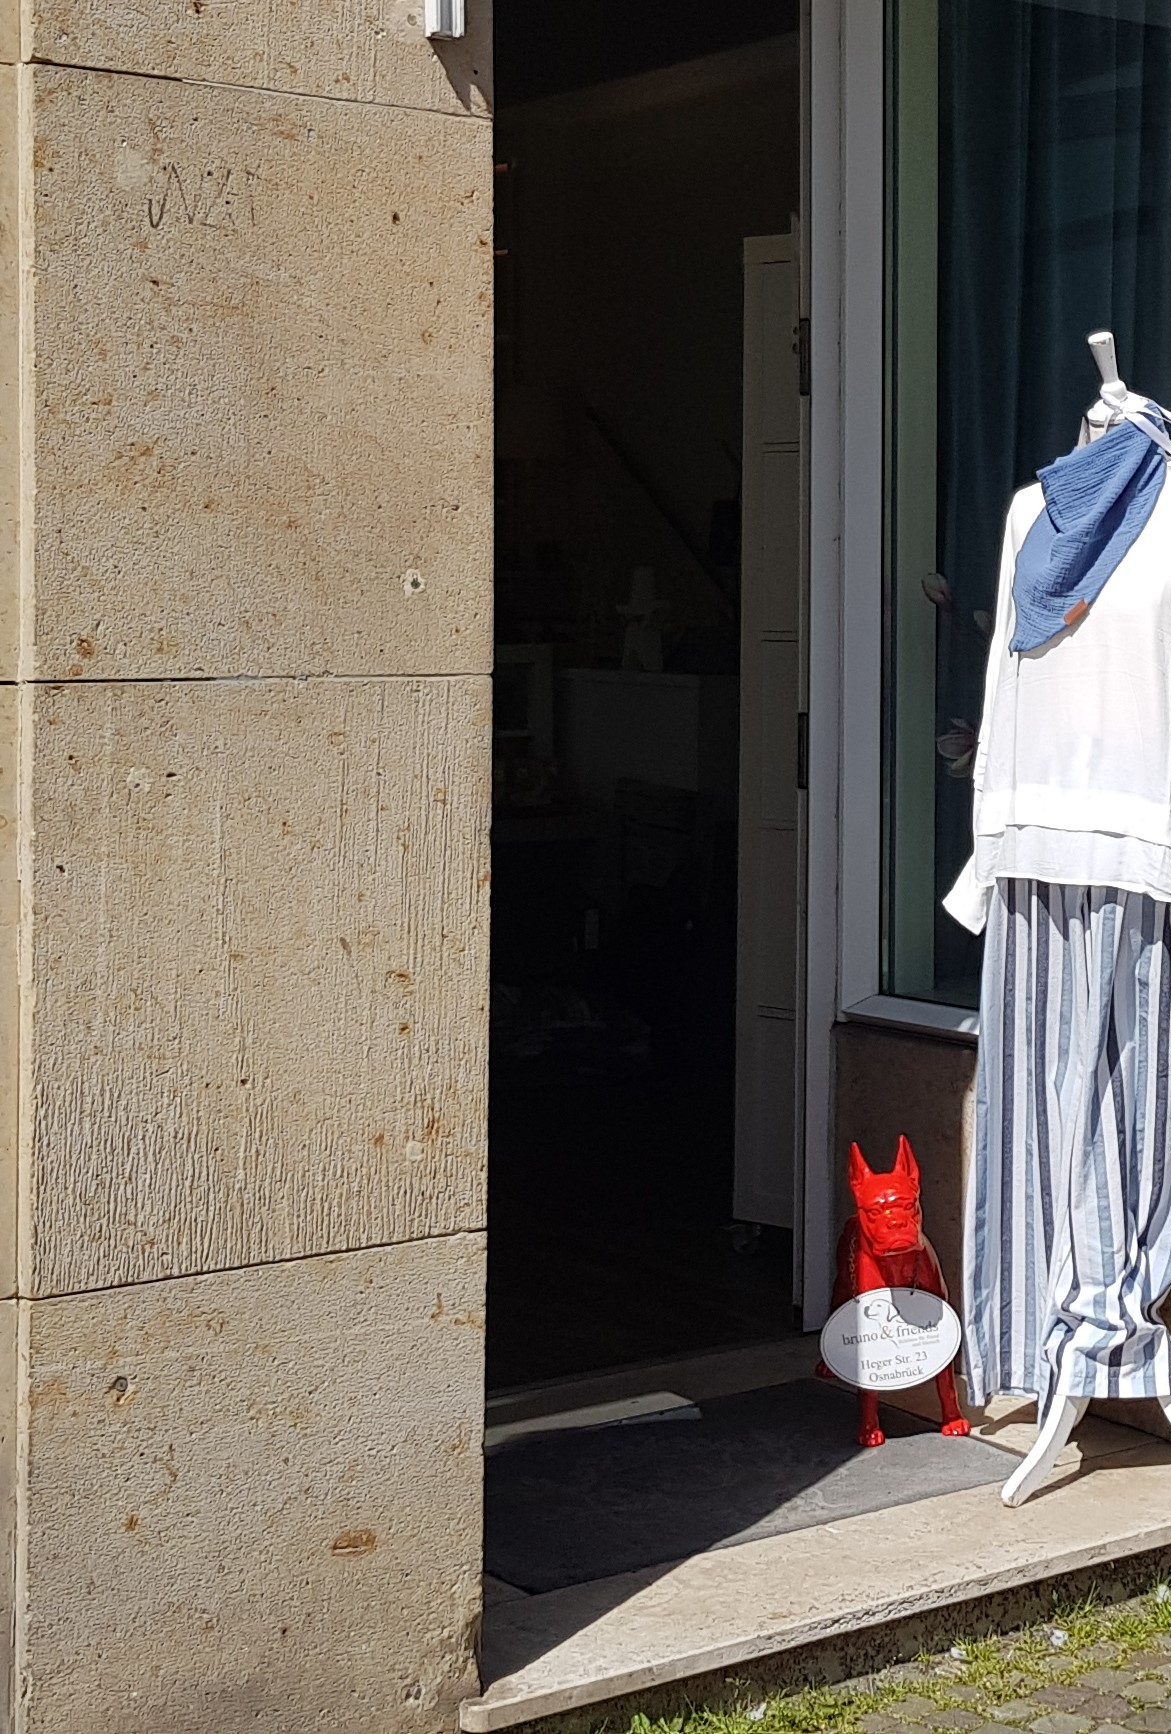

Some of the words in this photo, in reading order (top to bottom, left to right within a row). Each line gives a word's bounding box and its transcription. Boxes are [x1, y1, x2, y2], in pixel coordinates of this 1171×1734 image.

[841, 1333, 878, 1346] bruno
[880, 1325, 893, 1340] &
[860, 1357, 892, 1371] Heger
[895, 1353, 913, 1365] Str.
[915, 1350, 928, 1362] 23
[868, 1365, 925, 1383] Osnabrück
